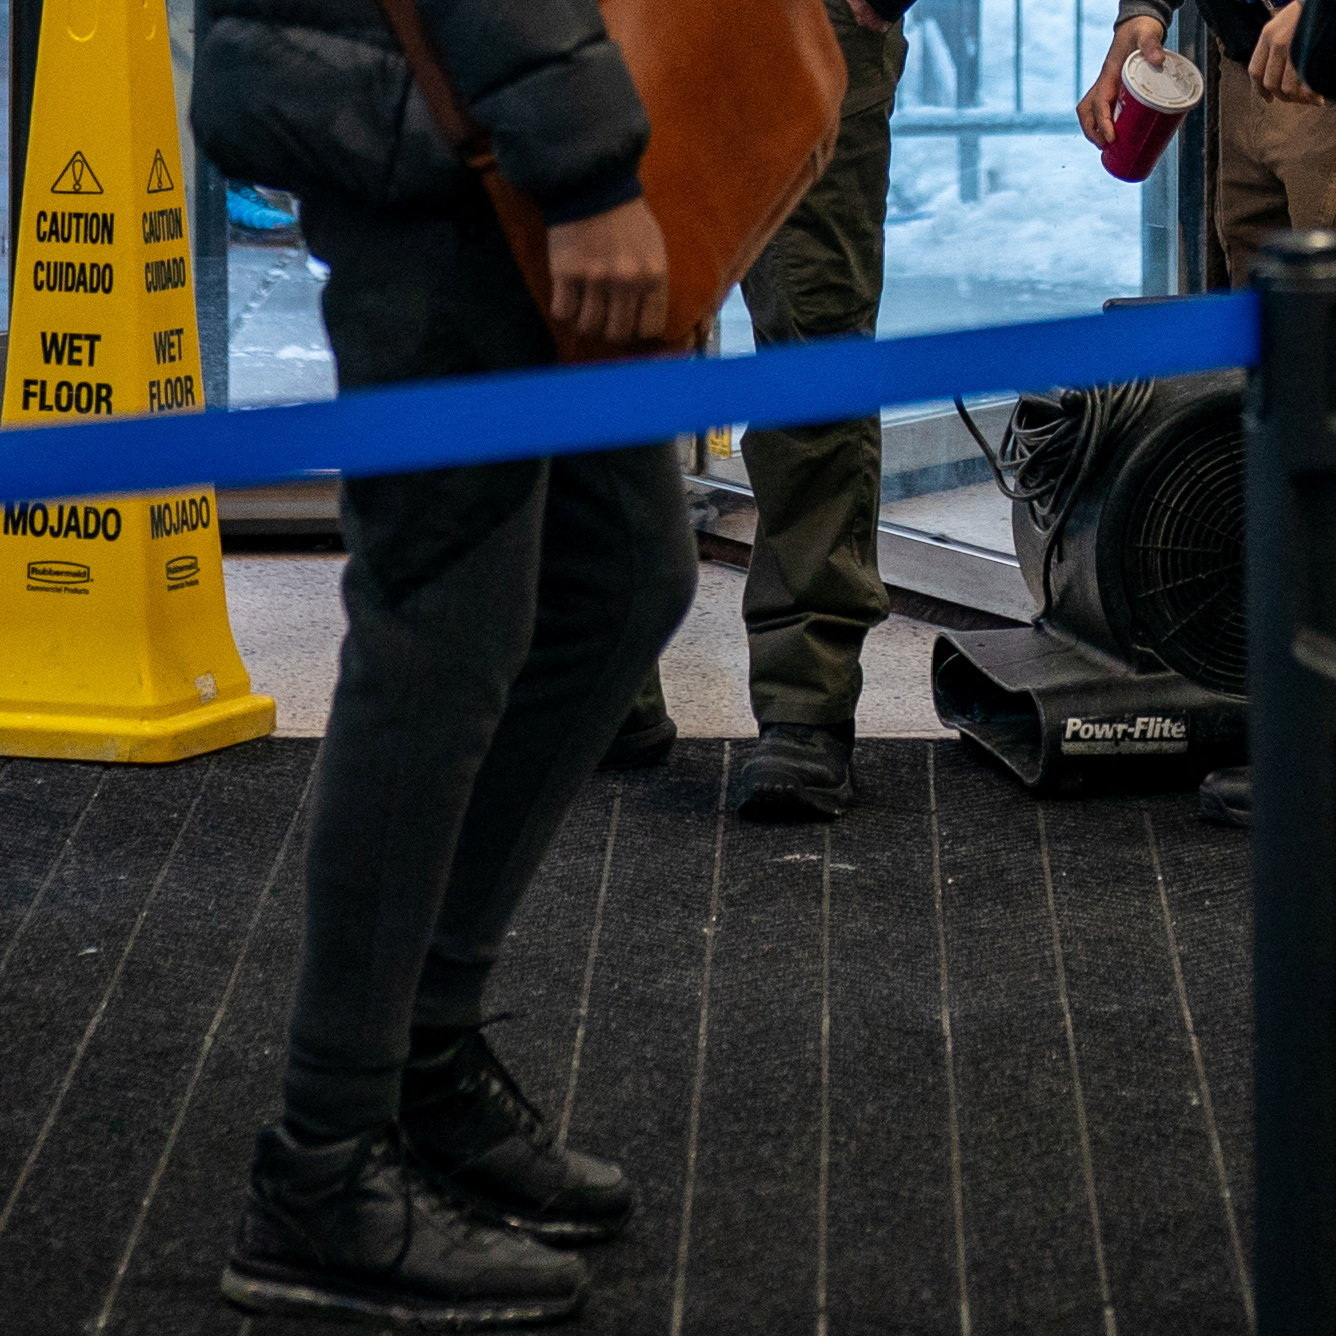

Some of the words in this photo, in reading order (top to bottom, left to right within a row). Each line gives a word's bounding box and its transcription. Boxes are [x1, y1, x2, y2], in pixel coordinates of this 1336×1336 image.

[37, 211, 114, 244] CAUTION
[142, 207, 183, 244] CAUTION
[33, 260, 114, 294] CUIDADO
[145, 256, 186, 293] CUIDADO
[41, 331, 102, 367] WET
[153, 327, 184, 365] WET
[22, 379, 113, 415] FLOOR
[148, 375, 195, 413] FLOOR
[3, 501, 122, 542] MOJADO
[151, 495, 211, 540] MOJADO
[31, 567, 87, 578] Rubbermaid
[1065, 717, 1186, 739] Powr-Flite
